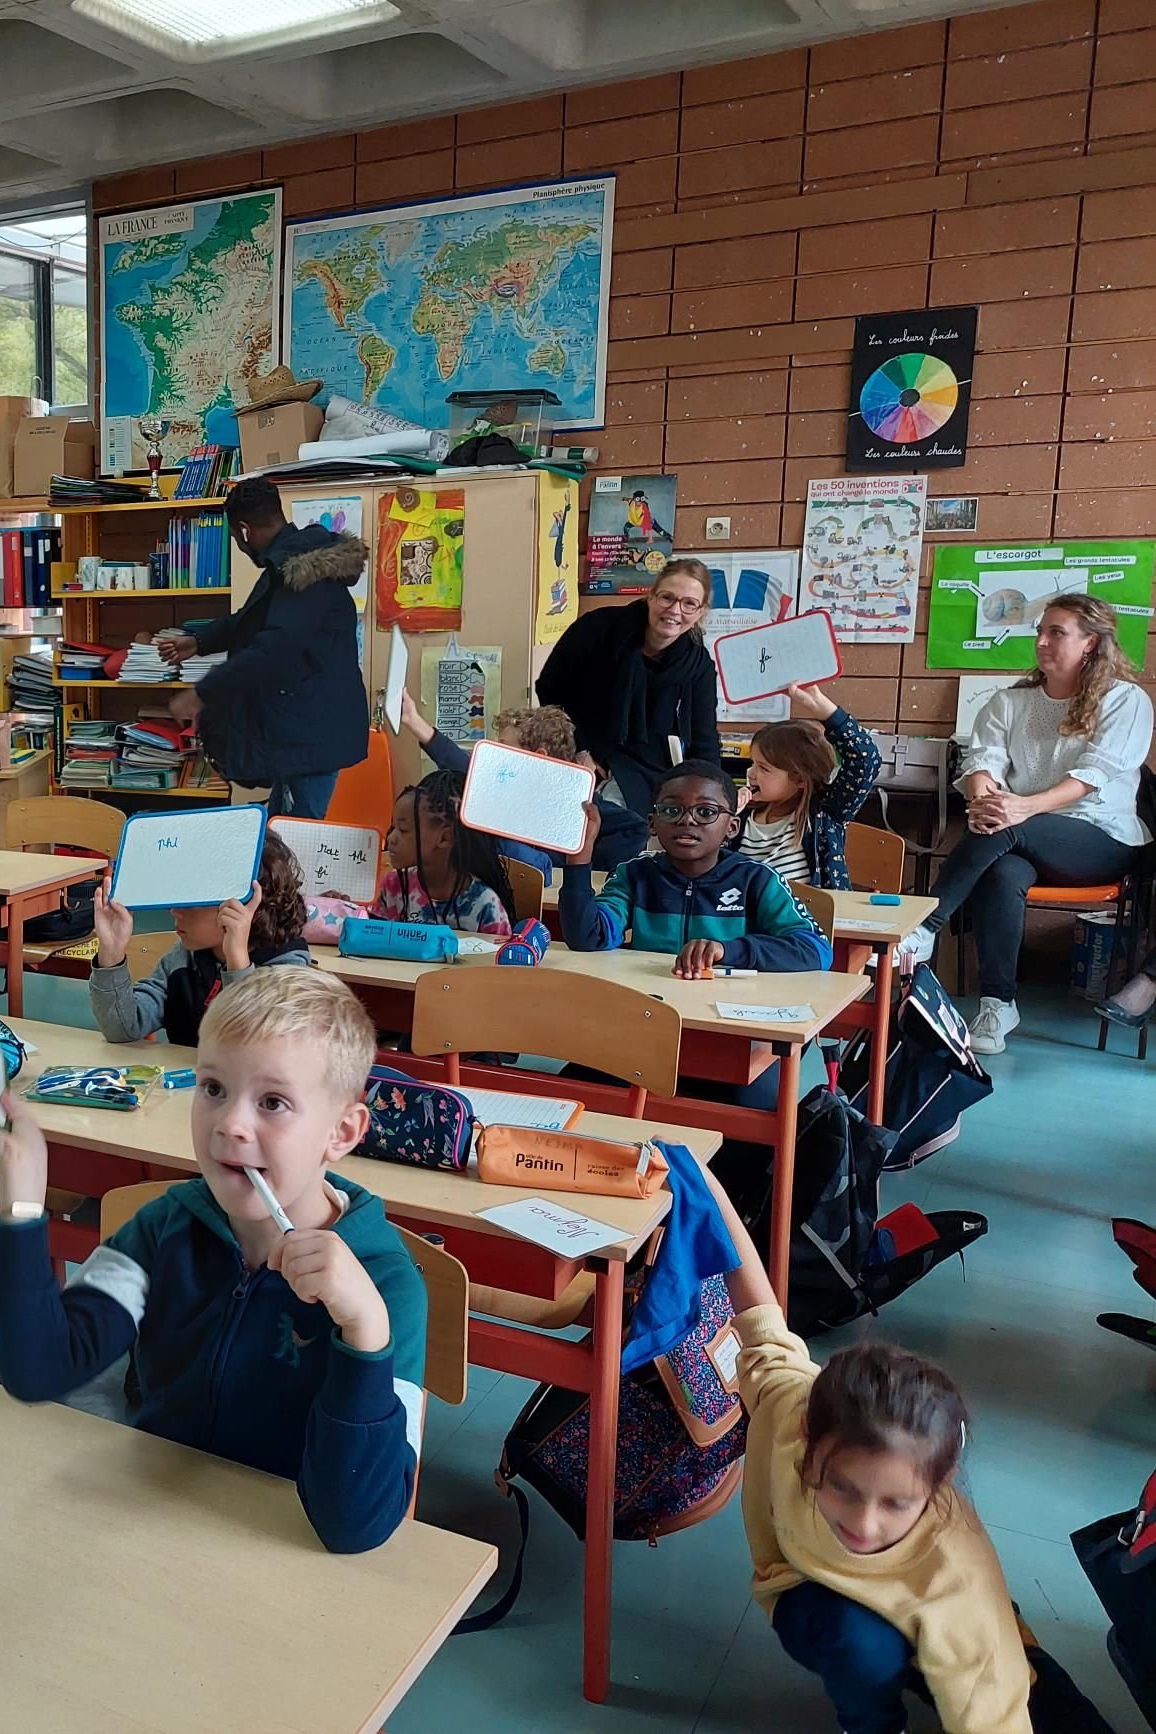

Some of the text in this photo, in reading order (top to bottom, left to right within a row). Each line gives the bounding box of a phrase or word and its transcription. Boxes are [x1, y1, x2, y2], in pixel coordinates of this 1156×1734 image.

[533, 183, 605, 199] Planisphère physique
[107, 216, 157, 236] LA FRANCE
[869, 328, 959, 346] Les couleurs froides
[864, 442, 963, 458] Les couleurs chaudes
[812, 482, 829, 491] Les
[830, 481, 845, 490] 50
[847, 479, 900, 489] inventions
[837, 489, 864, 498] changé
[986, 549, 1042, 561] L'escargot
[397, 928, 428, 942] Pantin
[516, 1153, 564, 1172] Pantin
